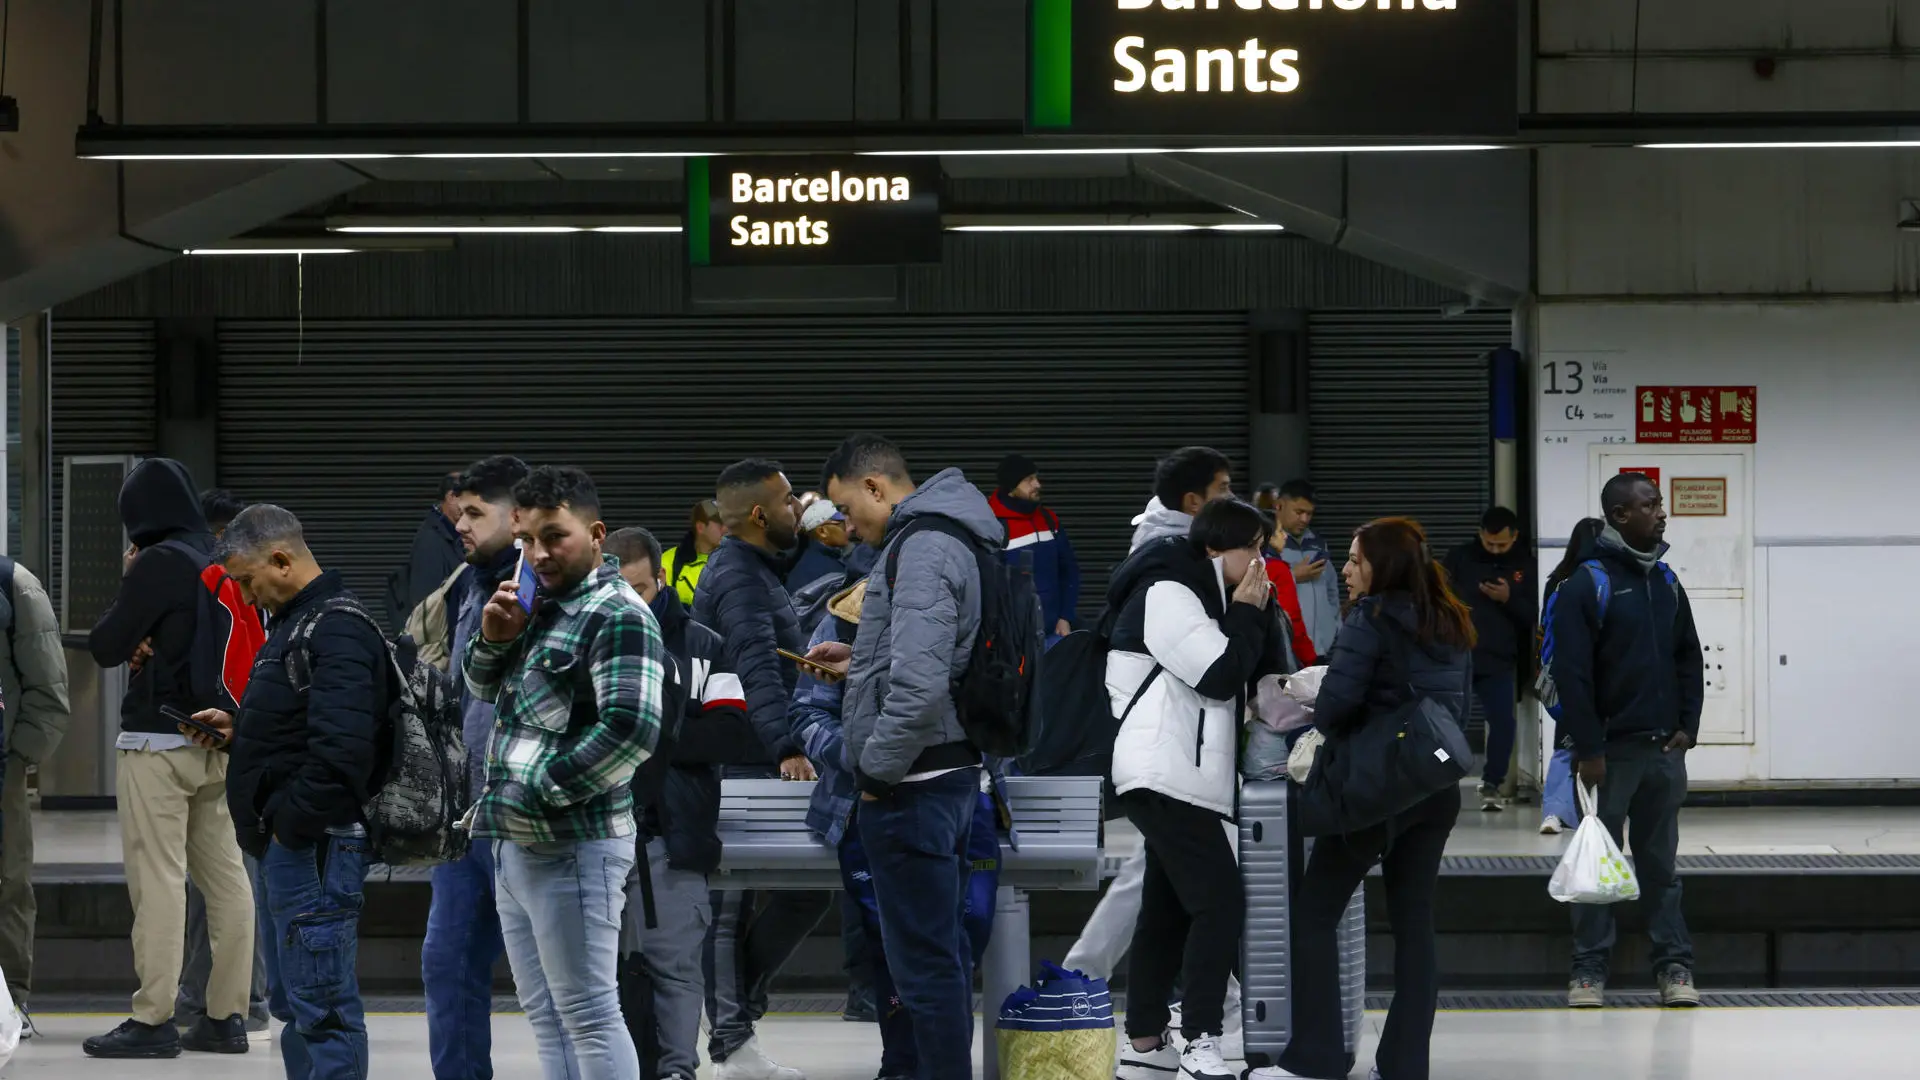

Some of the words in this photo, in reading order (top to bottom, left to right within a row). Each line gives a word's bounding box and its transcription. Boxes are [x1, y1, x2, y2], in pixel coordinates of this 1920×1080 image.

[1113, 36, 1300, 93] Sants
[731, 170, 910, 203] Barcelona
[730, 215, 829, 246] Sants
[1543, 361, 1584, 395] 13
[1565, 404, 1585, 420] C4
[1592, 412, 1614, 420] Sector
